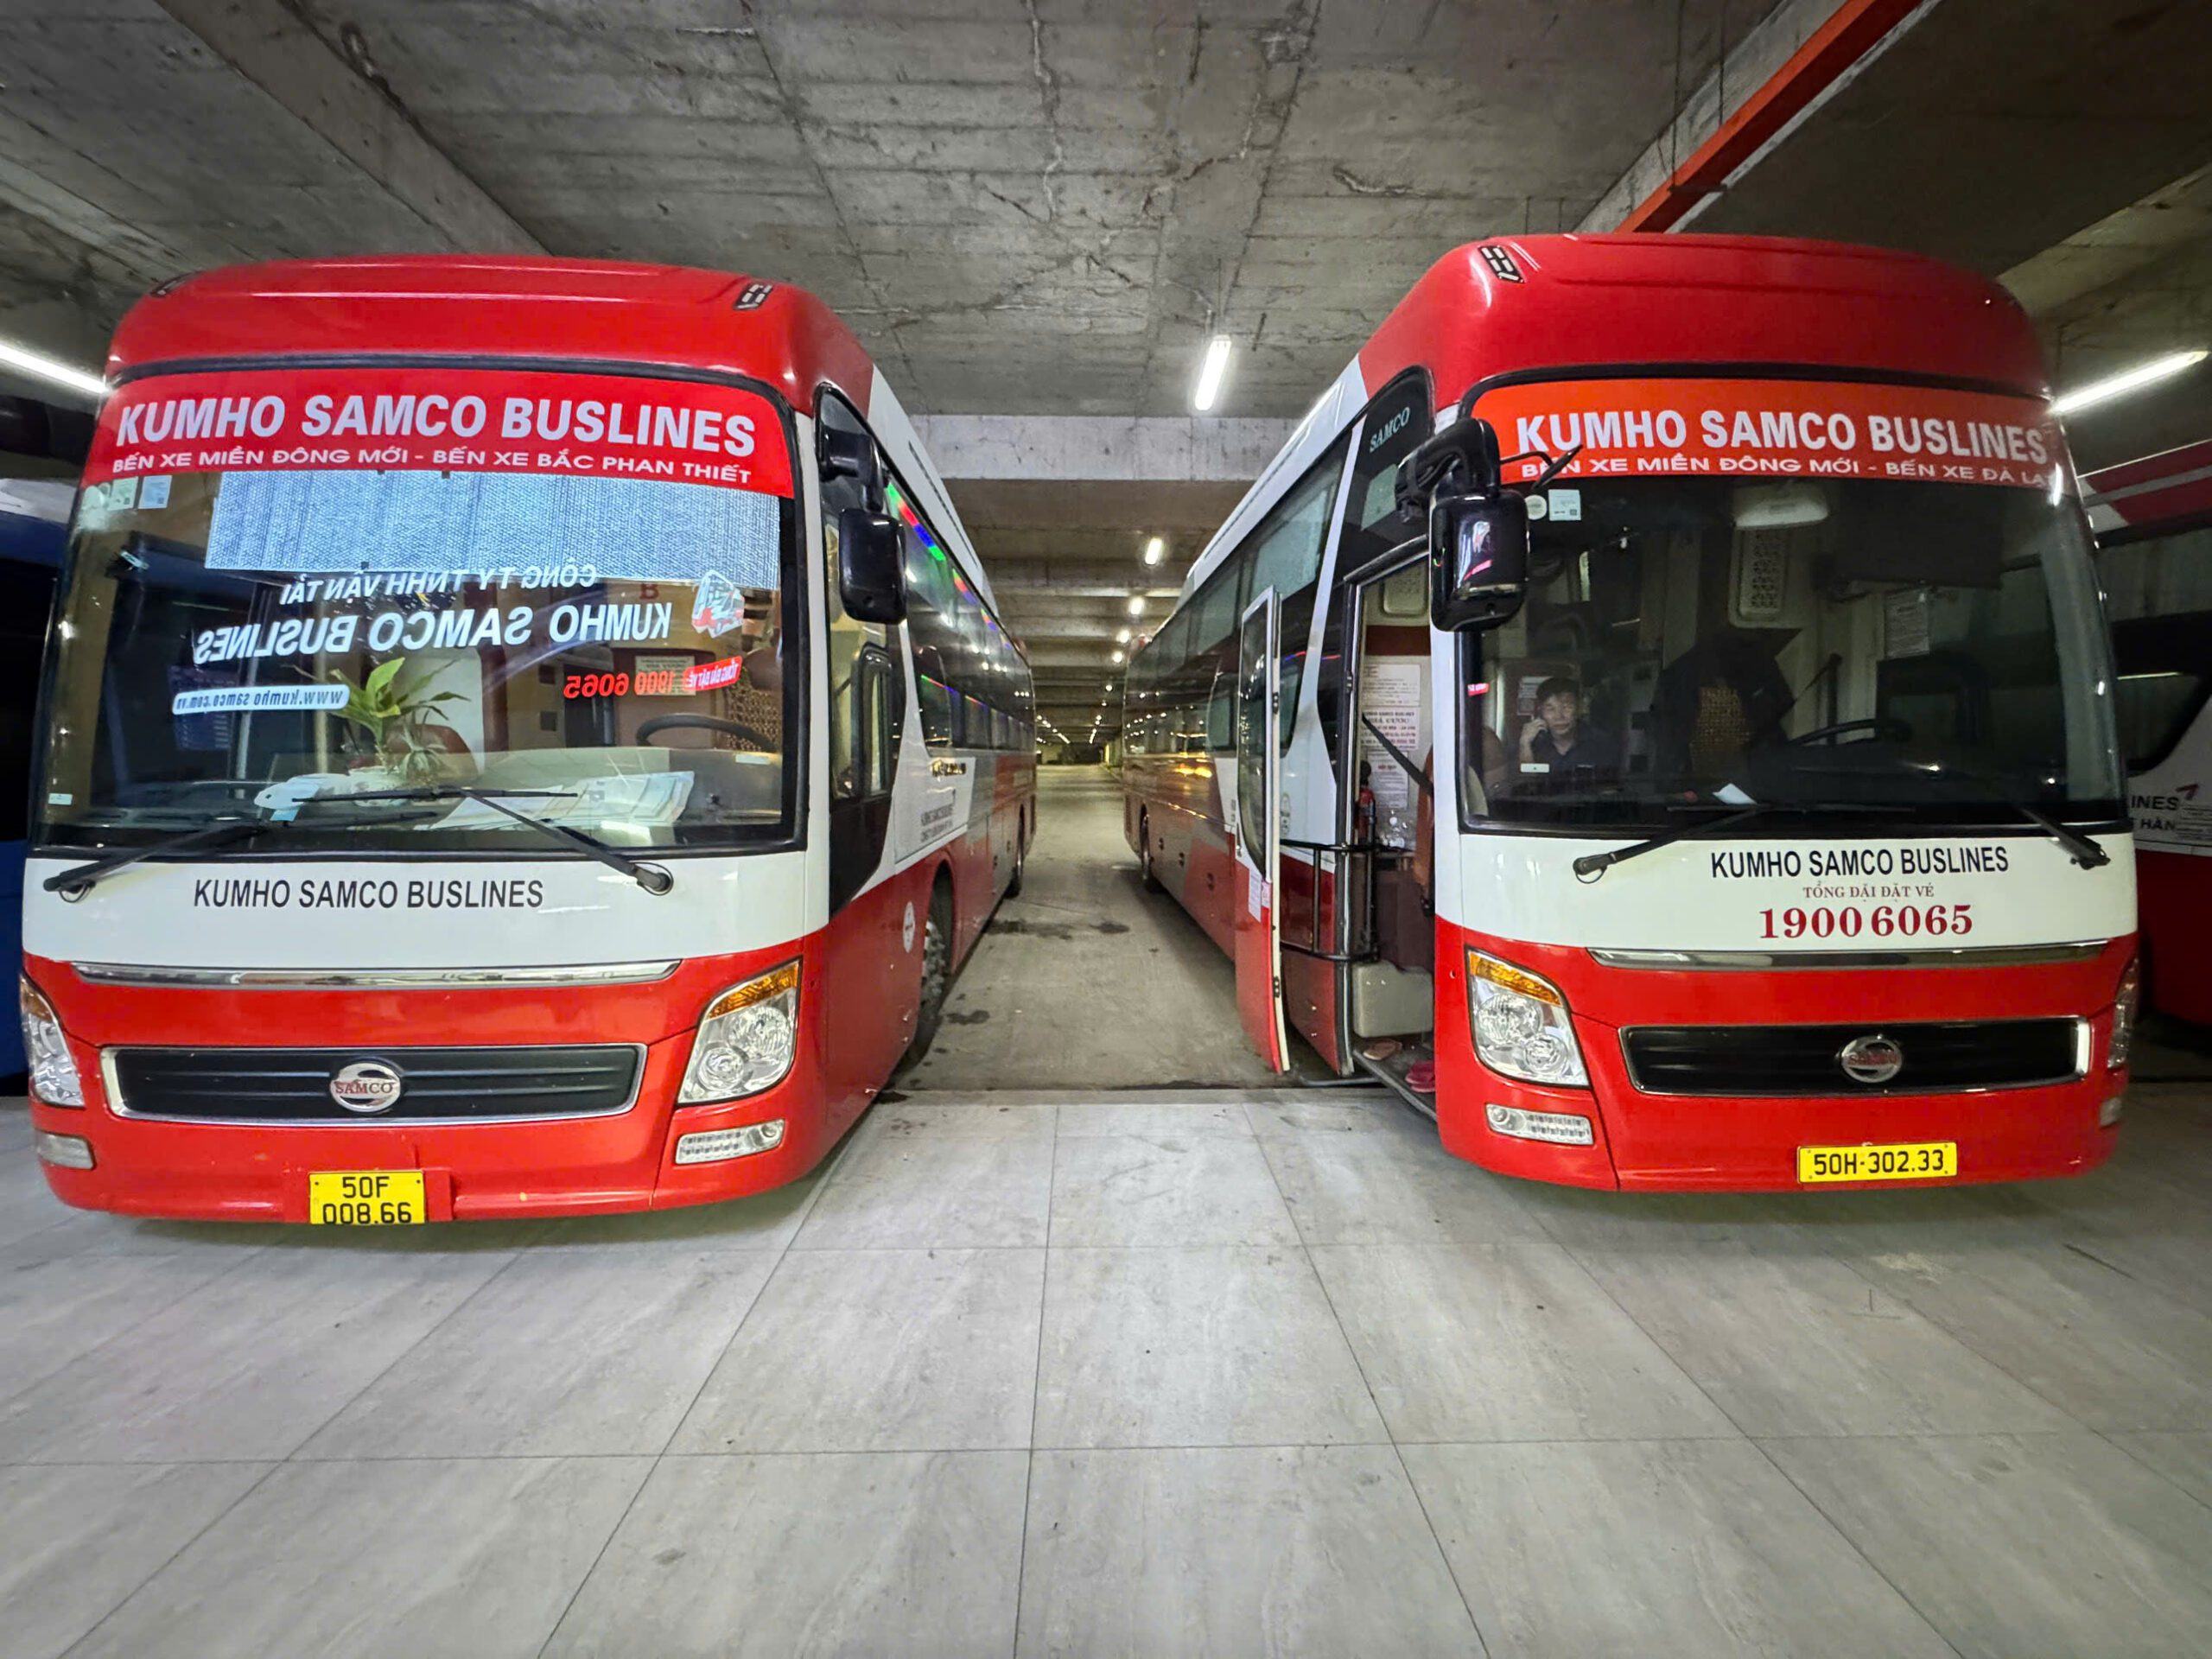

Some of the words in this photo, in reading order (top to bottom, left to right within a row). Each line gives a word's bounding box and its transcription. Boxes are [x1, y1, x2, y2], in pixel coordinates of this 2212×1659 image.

[116, 395, 285, 447] KUMHO
[302, 395, 486, 437] SAMCO
[500, 397, 755, 457] BUSLINES
[1369, 406, 1410, 453] SAMCO
[1516, 410, 1687, 454] KUMHO
[1700, 410, 1856, 451] SAMCO
[1867, 415, 2048, 465] BUSLINES
[112, 452, 155, 474] BẾN
[159, 453, 191, 467] XE
[199, 446, 264, 466] MIỀN
[272, 447, 350, 464] ĐÔNG
[359, 445, 408, 464] MỚI
[433, 446, 486, 466] BẾN
[493, 451, 529, 467] XE
[537, 448, 594, 469] BẮC
[602, 456, 674, 475] PHAN
[682, 462, 751, 484] THIẾT
[1589, 458, 1628, 473] XE
[1637, 452, 1709, 472] MIỀN
[1719, 454, 1802, 472] ĐÔNG
[1809, 456, 1859, 474] MỚI
[1885, 459, 1936, 477] BẾN
[1942, 465, 1974, 480] XE
[2021, 471, 2056, 488] LẠ
[1711, 850, 1802, 878] KUMHO
[1809, 849, 1893, 876] SAMCO
[1901, 846, 2009, 874] BUSLINES
[193, 880, 290, 907] KUMHO
[298, 880, 398, 908] SAMCO
[406, 880, 544, 908] BUSLINES
[1803, 880, 1845, 899] TỔNG
[1881, 882, 1910, 902] ĐẶT
[1915, 881, 1935, 898] VÉ
[1759, 906, 1863, 938] 1900
[1871, 904, 1973, 937] 6065
[334, 1081, 396, 1095] SAMCO
[1814, 1149, 1944, 1175] 50H-302.33
[342, 1175, 390, 1198] 50F
[322, 1202, 412, 1224] 008.66
